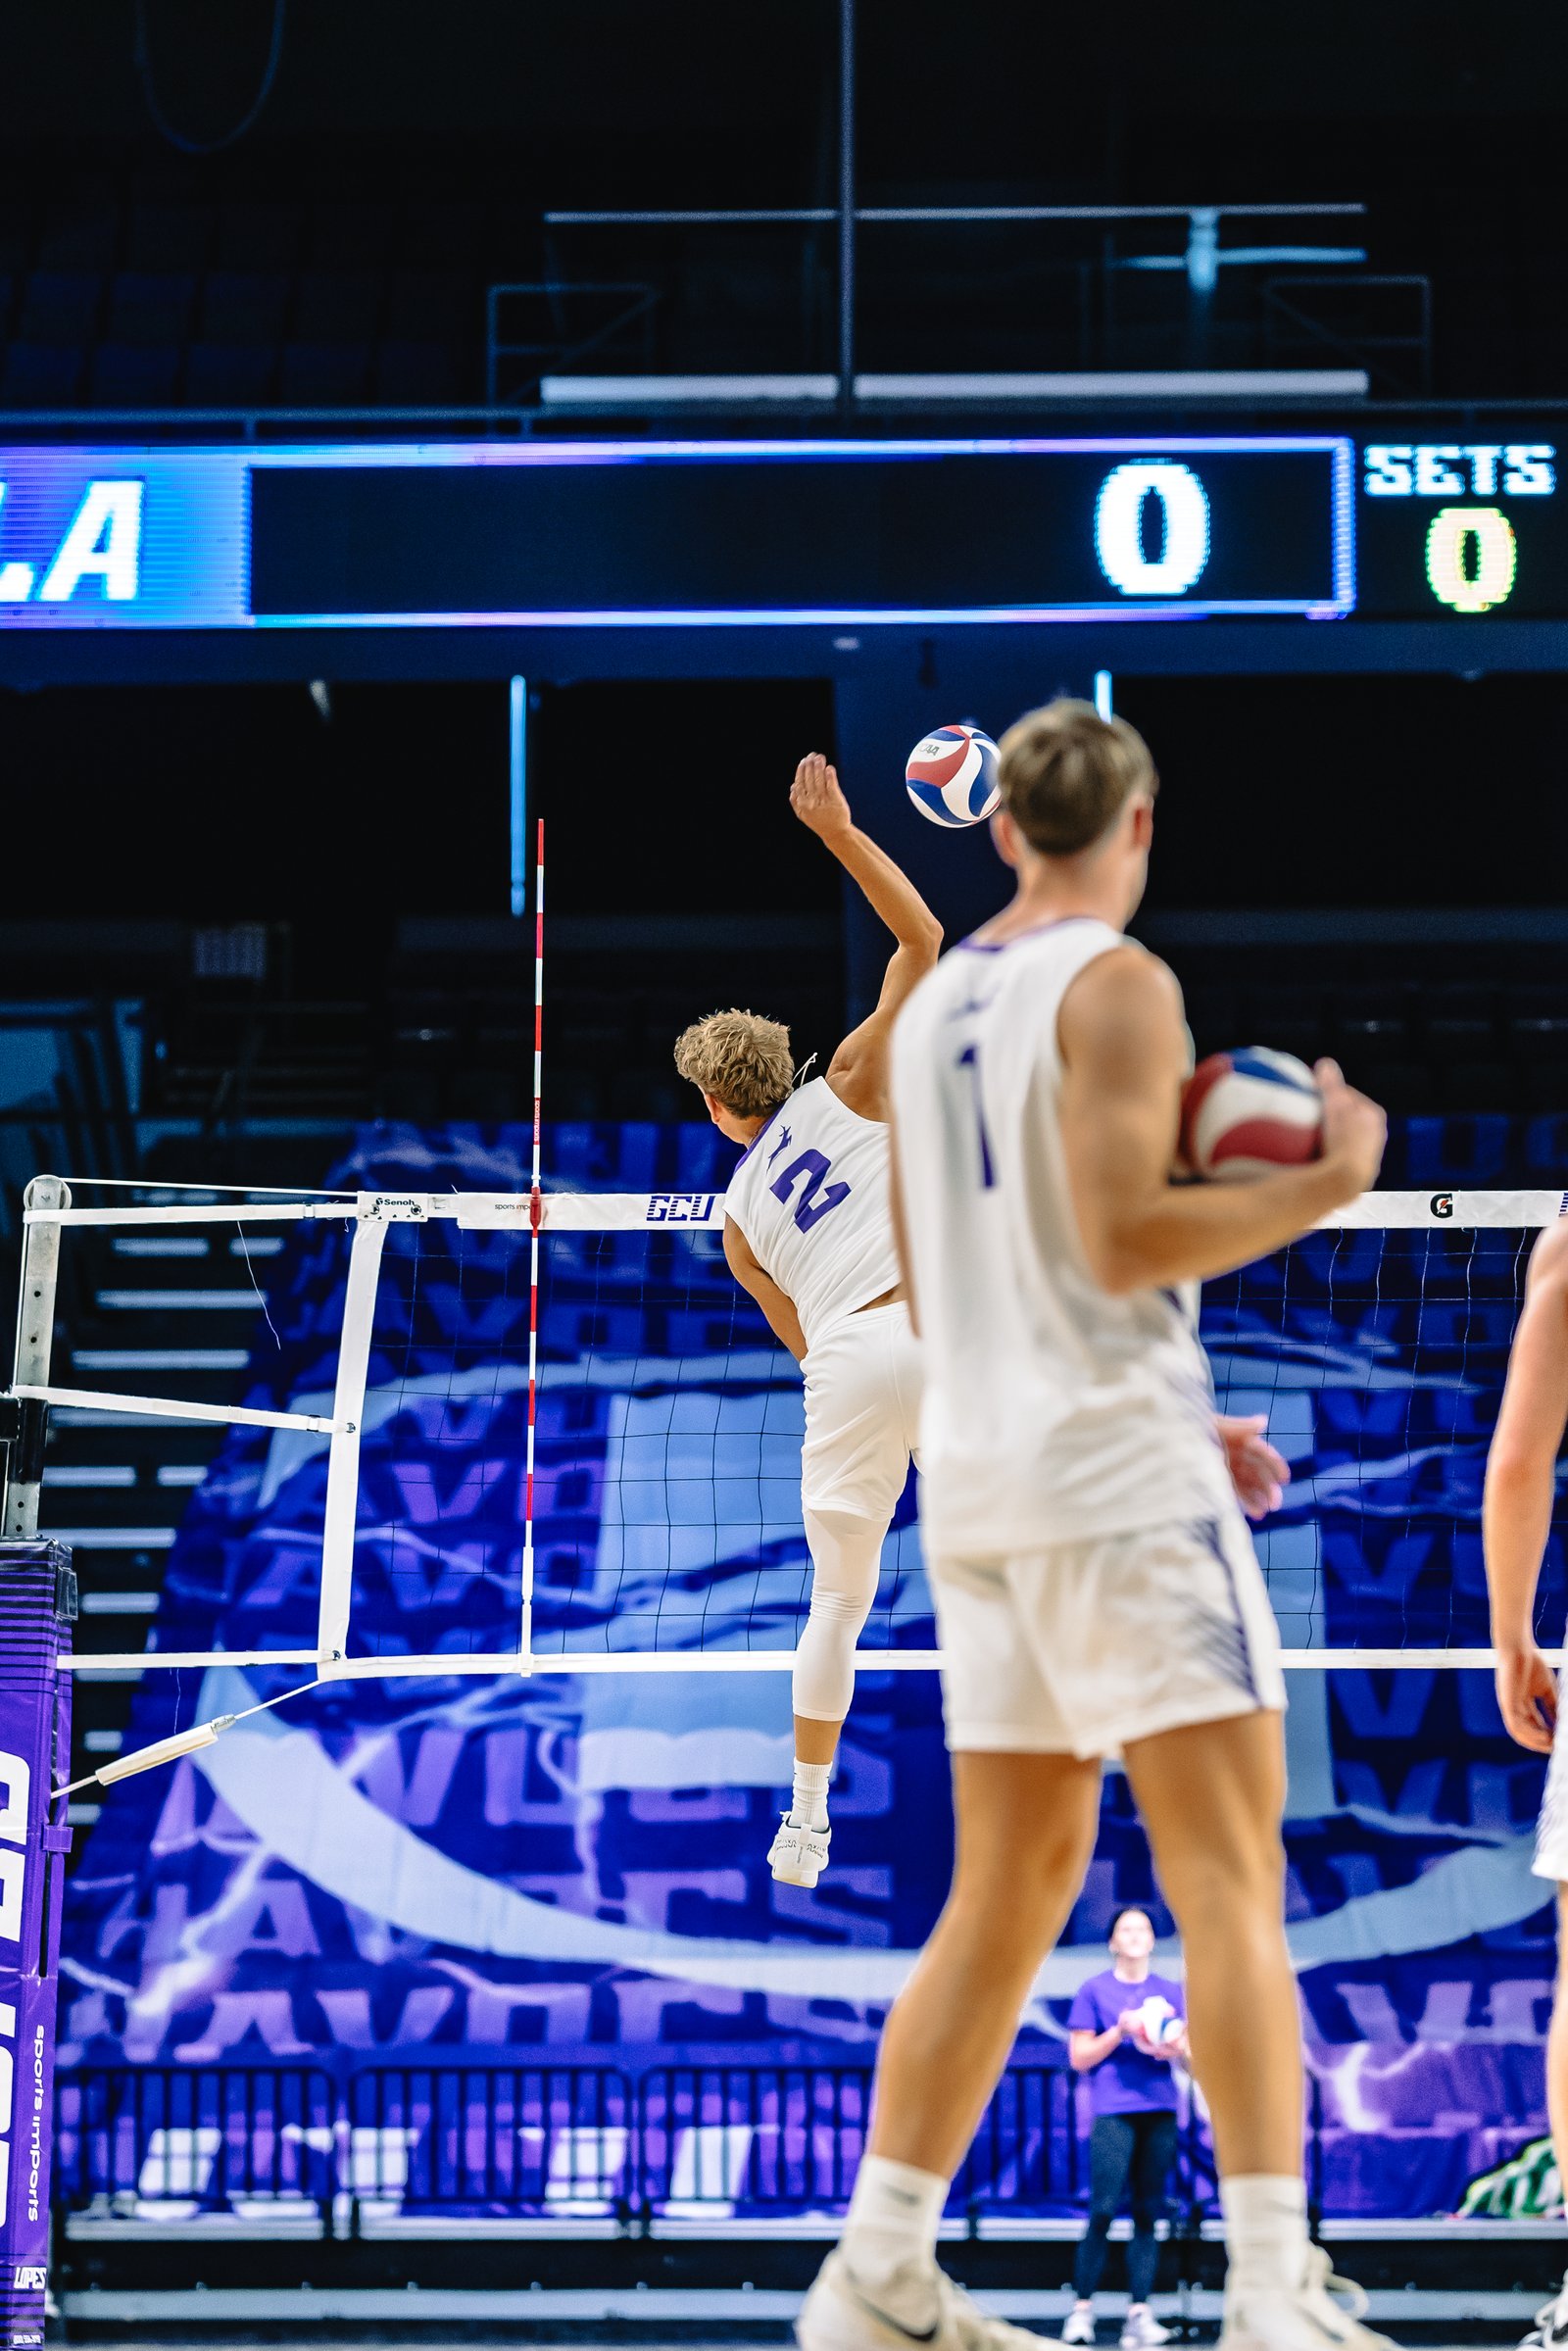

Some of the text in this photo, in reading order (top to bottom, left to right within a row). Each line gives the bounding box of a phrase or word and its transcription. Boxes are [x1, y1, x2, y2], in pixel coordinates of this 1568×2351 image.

[1364, 444, 1555, 495] SETS
[1095, 461, 1209, 596] 0
[1427, 507, 1516, 612] 0
[646, 1195, 716, 1221] GCU
[769, 1149, 852, 1234] 2
[1430, 1193, 1452, 1218] G
[27, 2025, 45, 2222] sports imports
[13, 2267, 46, 2289] LOPES
